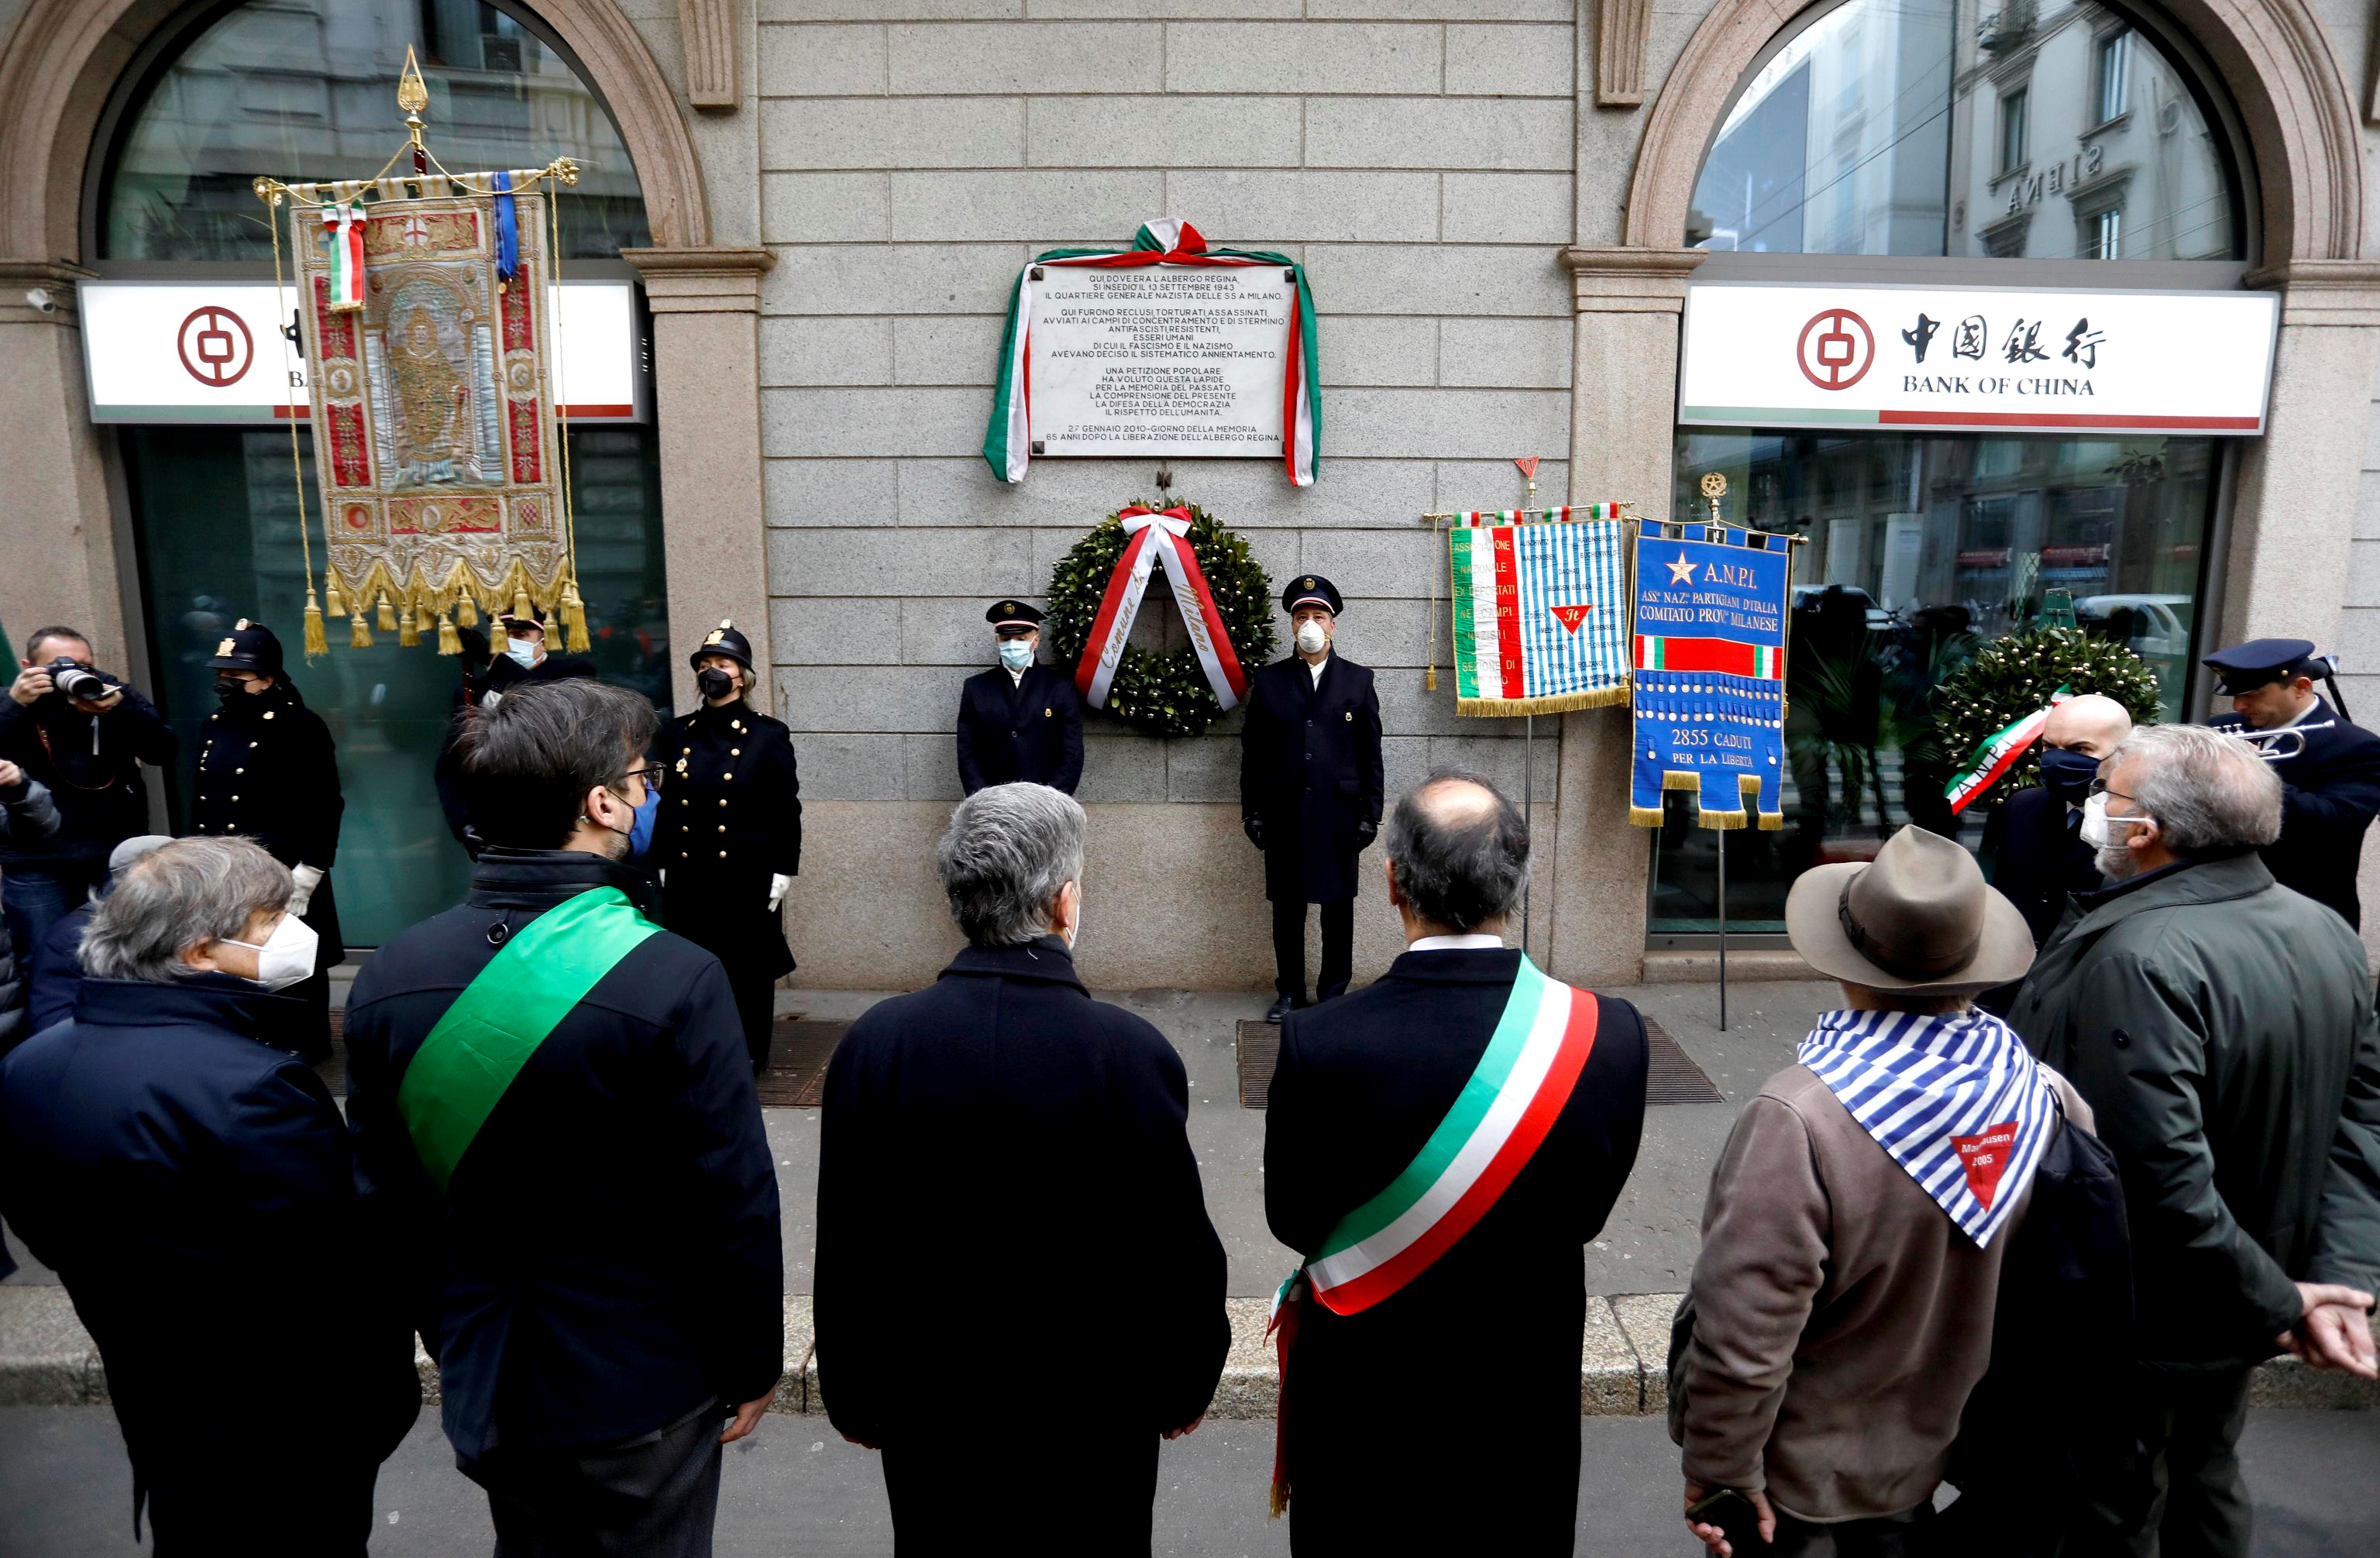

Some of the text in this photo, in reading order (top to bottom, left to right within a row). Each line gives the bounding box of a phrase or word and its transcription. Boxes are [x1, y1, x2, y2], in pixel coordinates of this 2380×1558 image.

[1205, 275, 1239, 284] REGINA,
[1903, 376, 2095, 396] BANK OF CHINA
[1460, 562, 1507, 574] NAZIONALE
[1704, 562, 1757, 589] A.N.P.I.
[1469, 585, 1515, 596] DEPORTATI
[1692, 593, 1740, 609] PARTIGIANI
[1743, 598, 1778, 614] D'ITALIA
[1481, 607, 1513, 618] CAMPI
[1640, 605, 1694, 622] COMITATO
[1731, 612, 1778, 631] MILANESE
[1468, 629, 1506, 640] NAZISTI
[1506, 660, 1515, 670] DI
[1672, 729, 1752, 749] 2855 CADUTI
[1673, 753, 1694, 764] PER
[1700, 754, 1718, 764] LA
[1972, 1154, 1993, 1167] 2005
